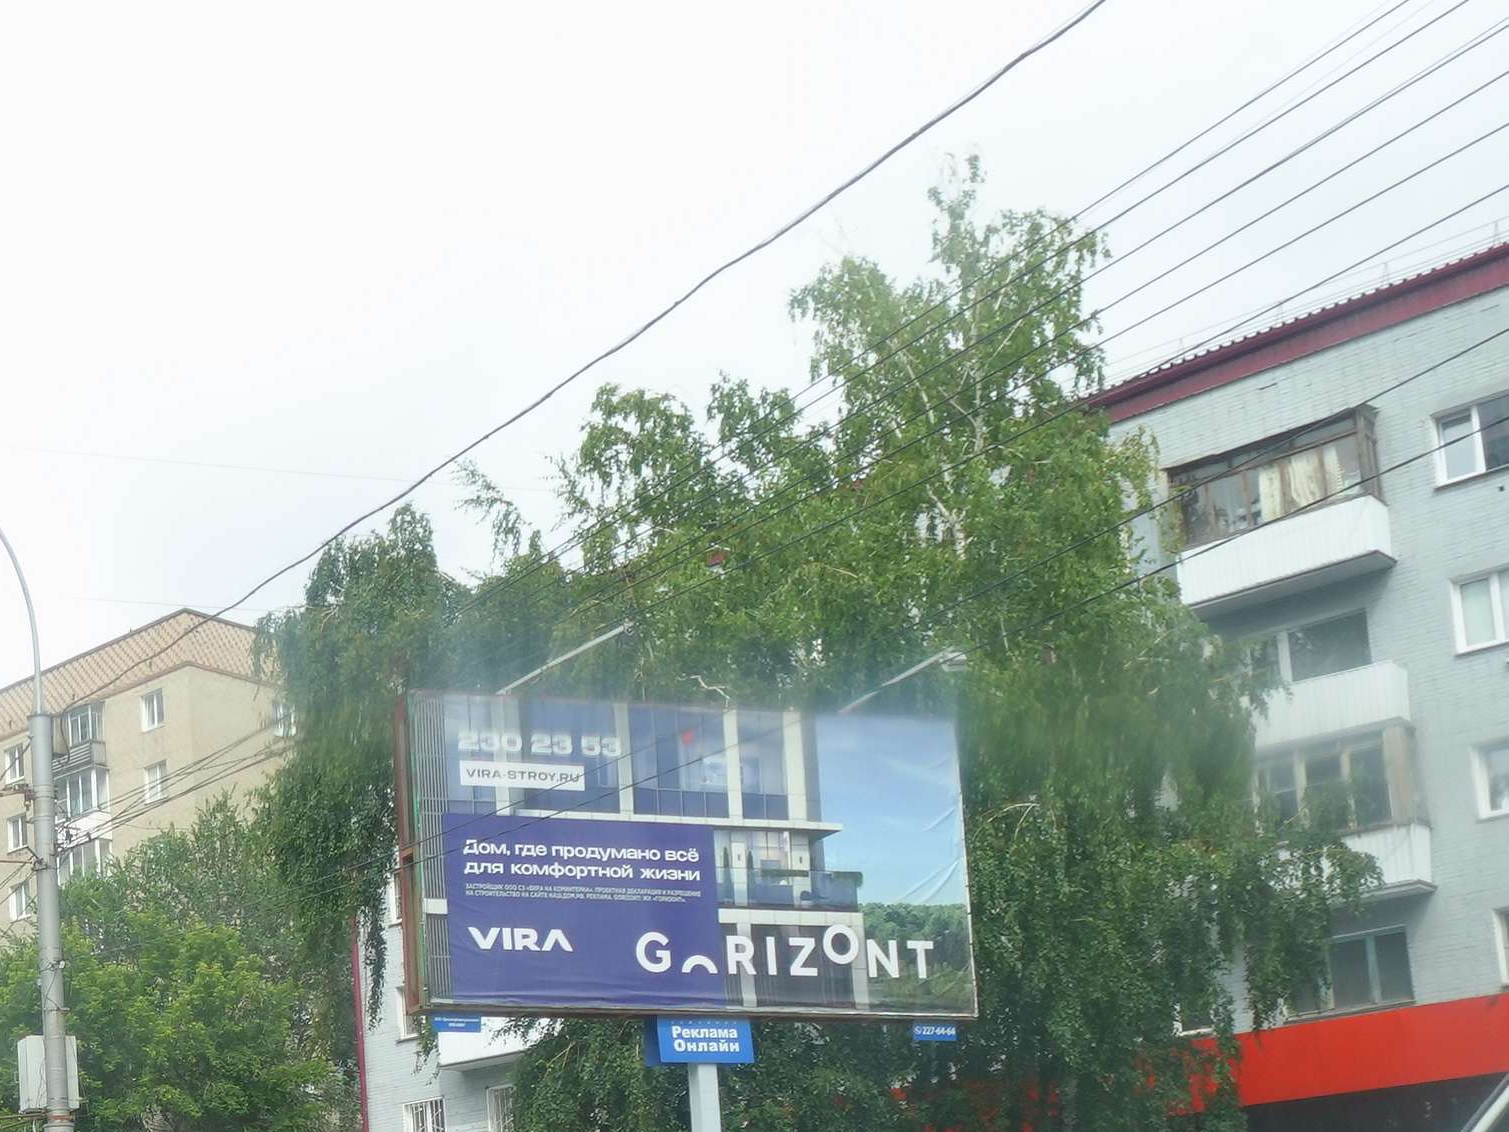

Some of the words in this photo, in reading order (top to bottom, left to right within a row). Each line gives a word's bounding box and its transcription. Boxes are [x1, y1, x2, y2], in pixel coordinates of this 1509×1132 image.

[458, 732, 523, 752] 230
[531, 734, 573, 755] 23
[581, 735, 622, 757] 53
[466, 768, 580, 783] VIRA-STROY.RU
[463, 839, 510, 857] Дом,
[514, 843, 547, 858] где
[552, 846, 661, 861] продумано
[665, 848, 699, 863] всё
[464, 861, 503, 875] для
[511, 861, 633, 879] комфортной
[640, 866, 701, 881] жизни
[467, 927, 574, 952] VIRA
[672, 1026, 738, 1039] Реклама
[673, 1039, 740, 1053] Онлайн
